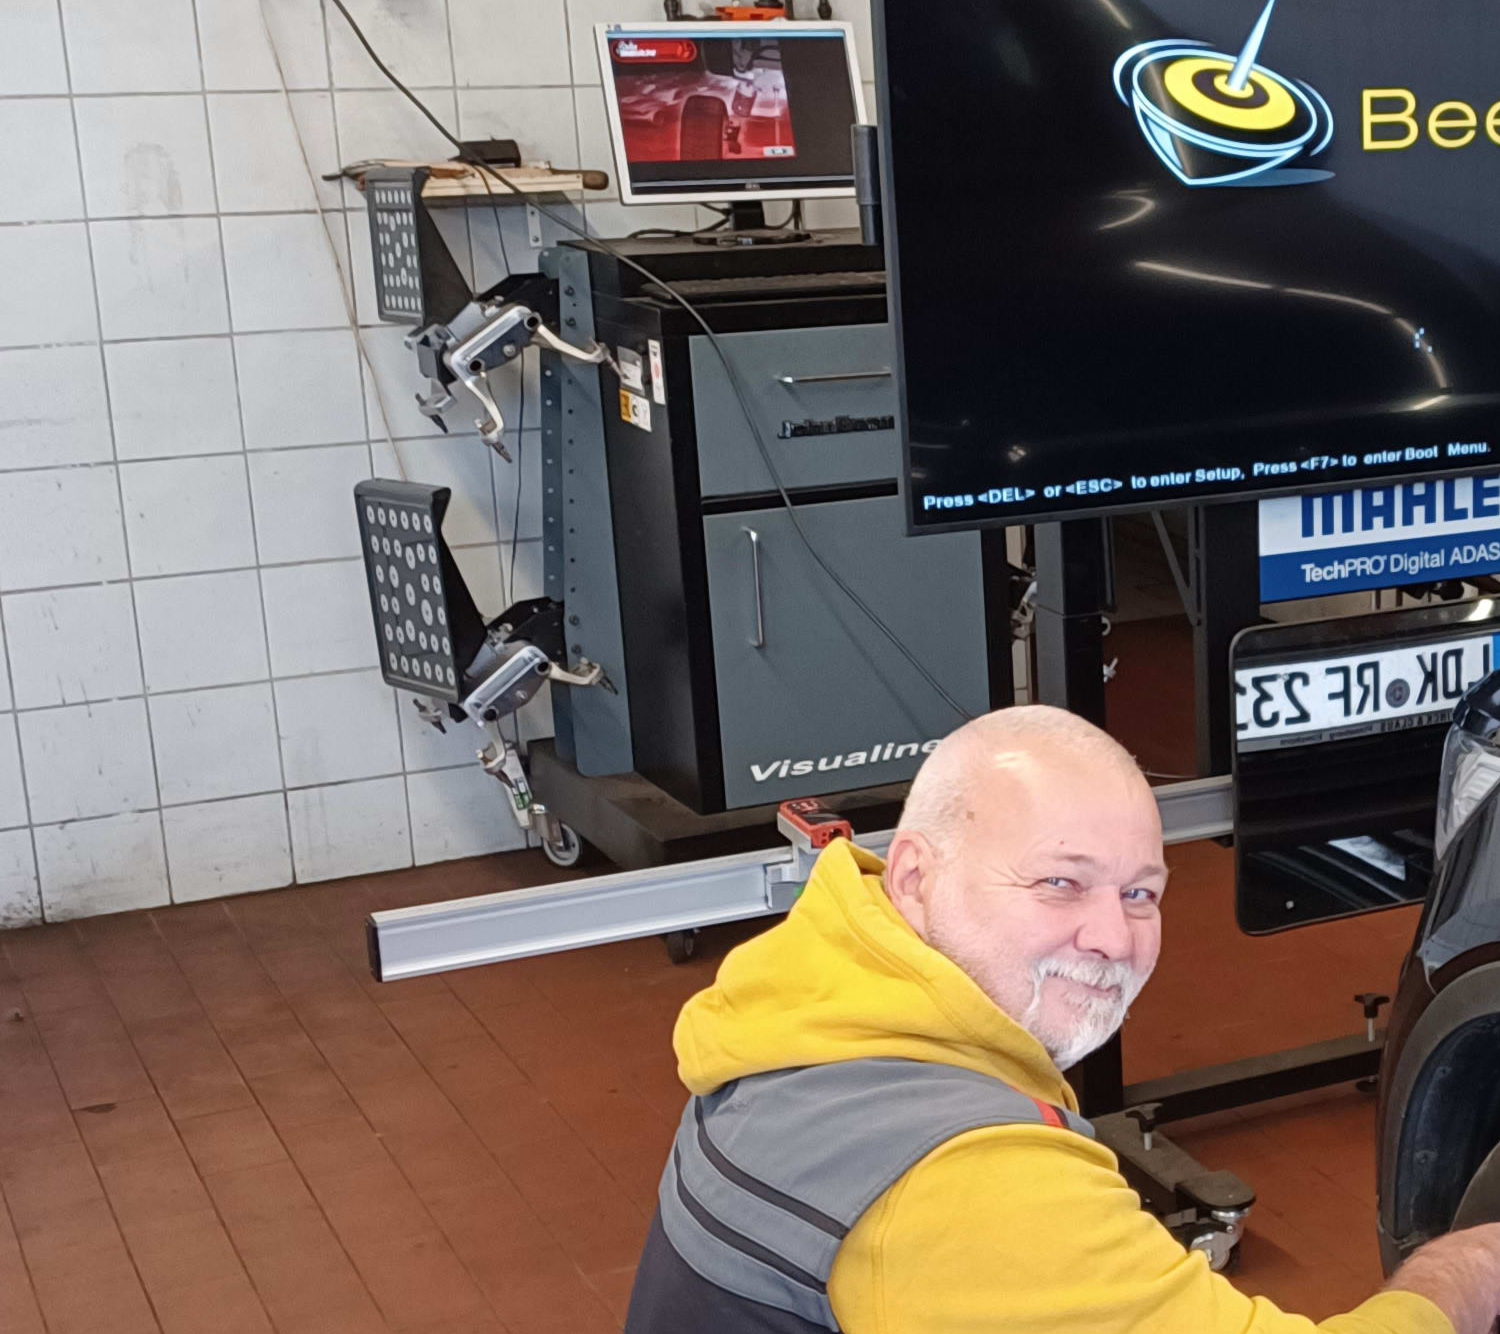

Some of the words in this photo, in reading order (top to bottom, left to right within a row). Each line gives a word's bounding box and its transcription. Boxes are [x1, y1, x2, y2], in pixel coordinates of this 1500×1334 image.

[923, 494, 974, 510] Press
[977, 487, 1036, 505] <DEL>
[1043, 485, 1063, 498] or
[1065, 478, 1123, 495] <ESC>
[1130, 475, 1147, 489] to
[1150, 470, 1192, 487] enter
[1195, 465, 1245, 483] Setup,
[1253, 458, 1297, 476] Press
[1301, 455, 1338, 470] <F7>
[1342, 453, 1357, 467] to
[1363, 449, 1402, 465] enter
[1405, 445, 1438, 460] Boot
[1447, 441, 1491, 457] Menu.
[1301, 475, 1500, 538] MAHLE
[1390, 549, 1445, 575] Digital
[1449, 542, 1500, 565] ADAS
[750, 739, 943, 782] Visualine
